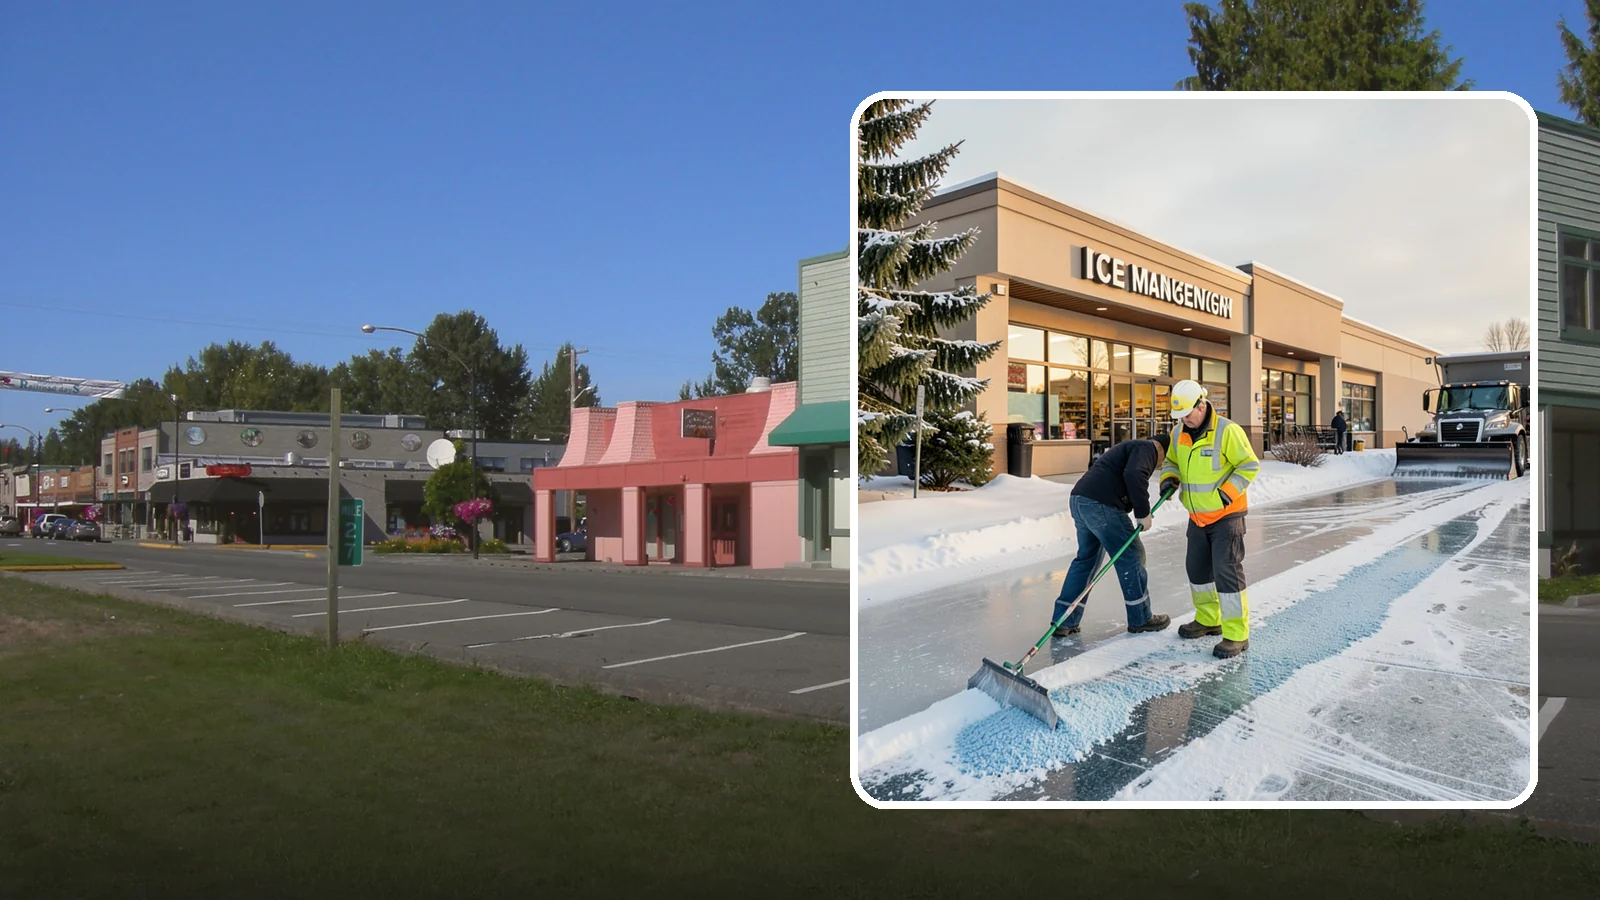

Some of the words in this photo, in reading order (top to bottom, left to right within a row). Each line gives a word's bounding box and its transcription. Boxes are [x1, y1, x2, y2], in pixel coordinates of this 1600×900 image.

[1084, 247, 1125, 289] ICE
[20, 379, 57, 392] Railroad
[341, 505, 362, 517] MILE
